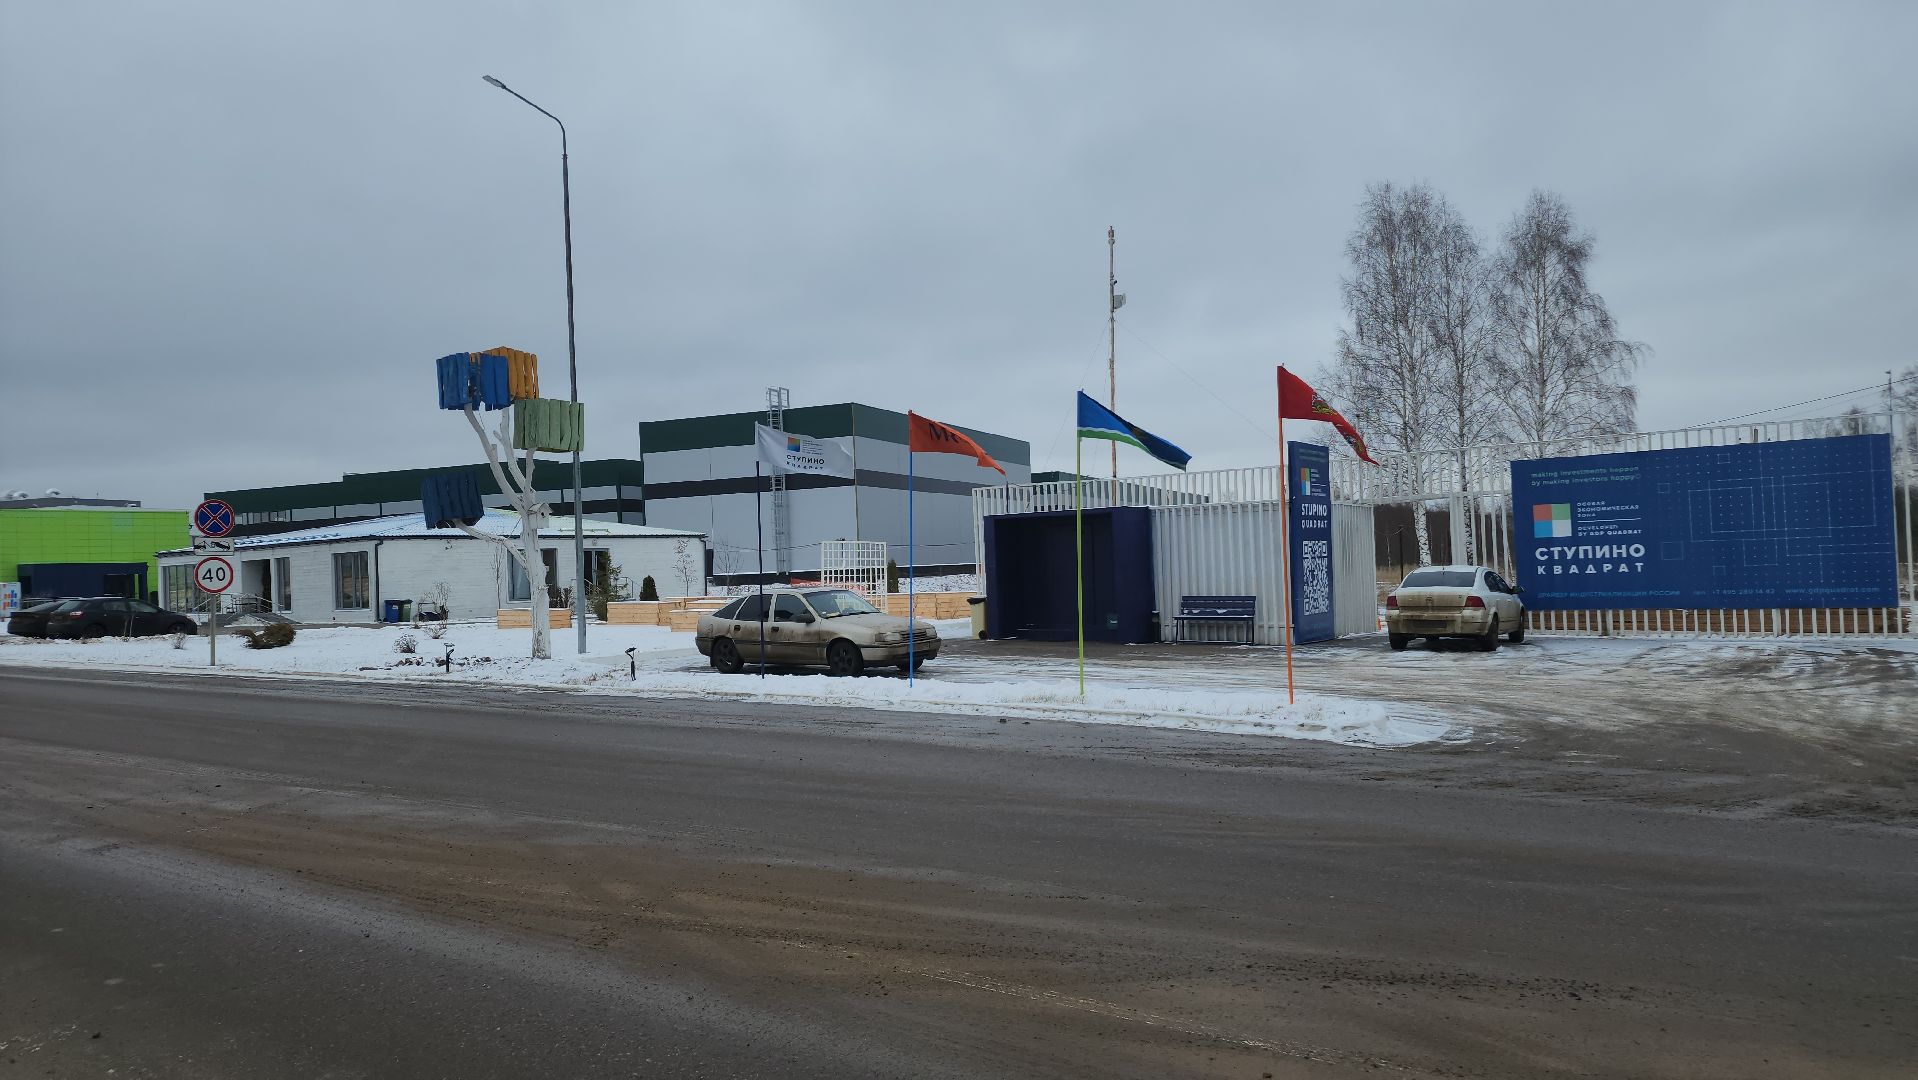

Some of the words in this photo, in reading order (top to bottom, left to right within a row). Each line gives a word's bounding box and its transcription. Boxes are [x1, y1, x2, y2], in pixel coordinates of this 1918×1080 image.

[786, 454, 825, 465] СТУПИНО
[1542, 478, 1570, 486] making
[1301, 503, 1328, 517] STUPINO
[1301, 519, 1328, 530] QUADRAT
[1607, 528, 1643, 536] QUADRAT
[1535, 543, 1646, 561] СТУПИНО
[1537, 562, 1644, 575] КВАДРАТ
[202, 567, 226, 583] 40
